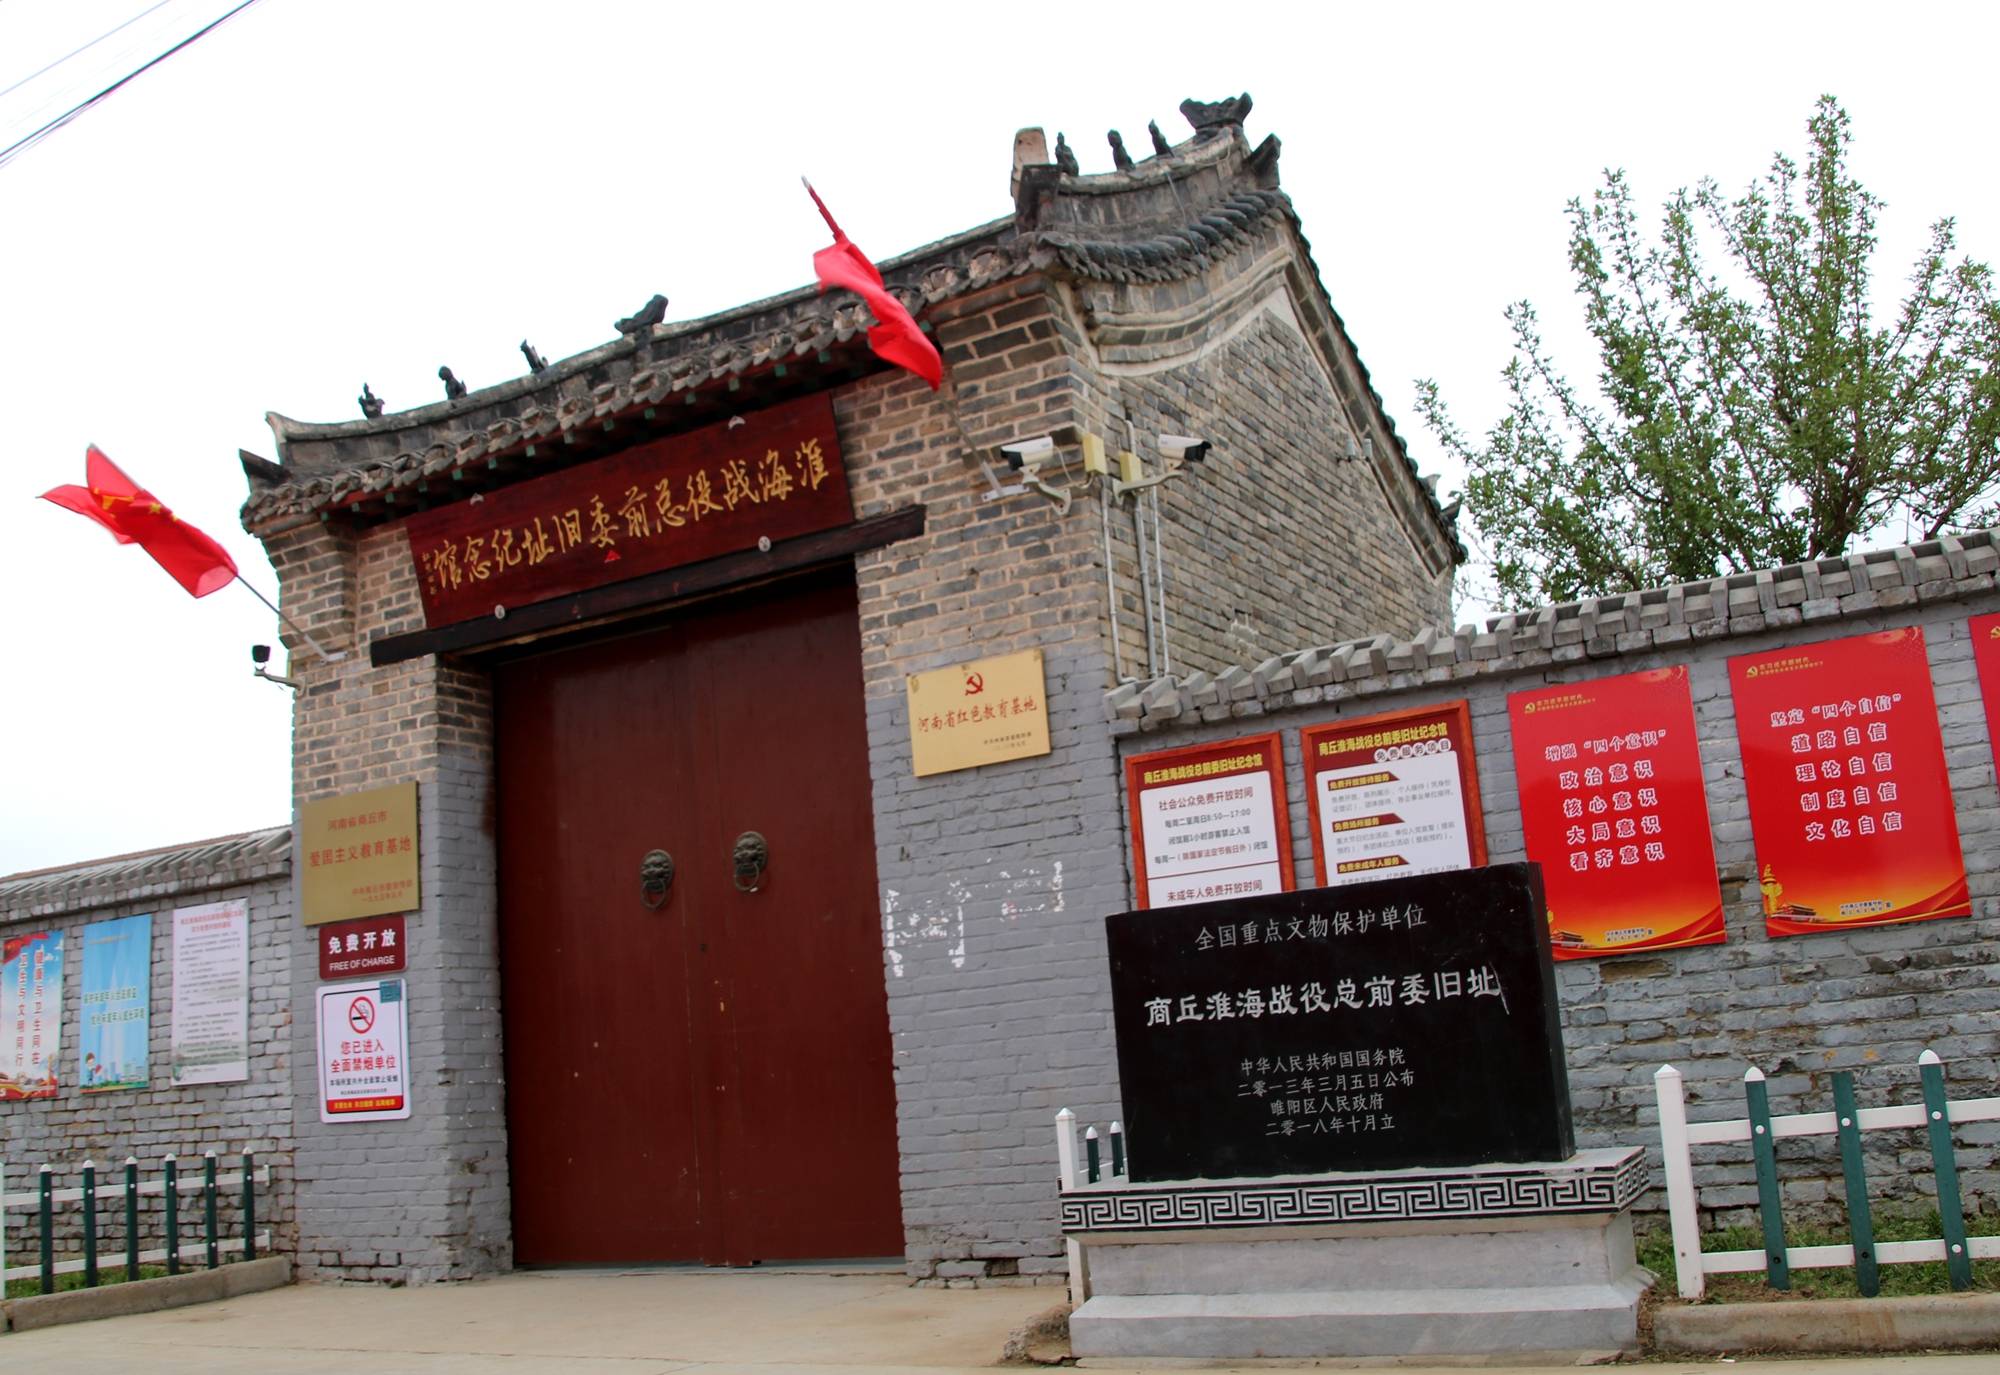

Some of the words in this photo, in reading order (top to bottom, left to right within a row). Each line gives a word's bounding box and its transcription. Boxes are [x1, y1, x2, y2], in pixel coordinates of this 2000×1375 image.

[434, 437, 830, 591] 淮海战役总前委旧址纪念馆
[918, 695, 1038, 733] 河南省红色教育基地
[1770, 693, 1902, 727] 坚定“四个自信”
[1377, 741, 1448, 761] 免费服务项目
[1545, 729, 1667, 762] 增强“四个意识”
[1792, 722, 1888, 753] 道路自信
[1559, 759, 1654, 791] 政治意识
[1796, 752, 1893, 783] 理论自信
[1158, 786, 1254, 811] 社会公众免费开放时间
[1563, 788, 1658, 819] 核心意识
[1800, 782, 1897, 813] 制度自信
[1566, 815, 1662, 846] 大局意识
[1805, 811, 1902, 842] 文化自信
[309, 835, 413, 867] 爱国主义教育基地
[1570, 842, 1665, 873] 看齐意识
[1167, 879, 1264, 902] 未成年人免费开放时间
[328, 928, 397, 956] 免费开放
[1194, 903, 1427, 951] 全国重点文物保护单位
[329, 960, 350, 972] FREE
[351, 958, 361, 969] OF
[362, 955, 395, 966] CHARGE
[1144, 966, 1501, 1027] 商丘淮海战役总前委旧址
[340, 1038, 385, 1056] 您已进入
[1240, 1047, 1406, 1076] 中华人民共和国国务院
[330, 1054, 397, 1073] 全面禁烟单位
[1236, 1069, 1415, 1098] 二零一三年三月五日公布
[1270, 1092, 1384, 1115] 睢阳区人民政府
[1265, 1112, 1396, 1137] 二零一八年十月立
